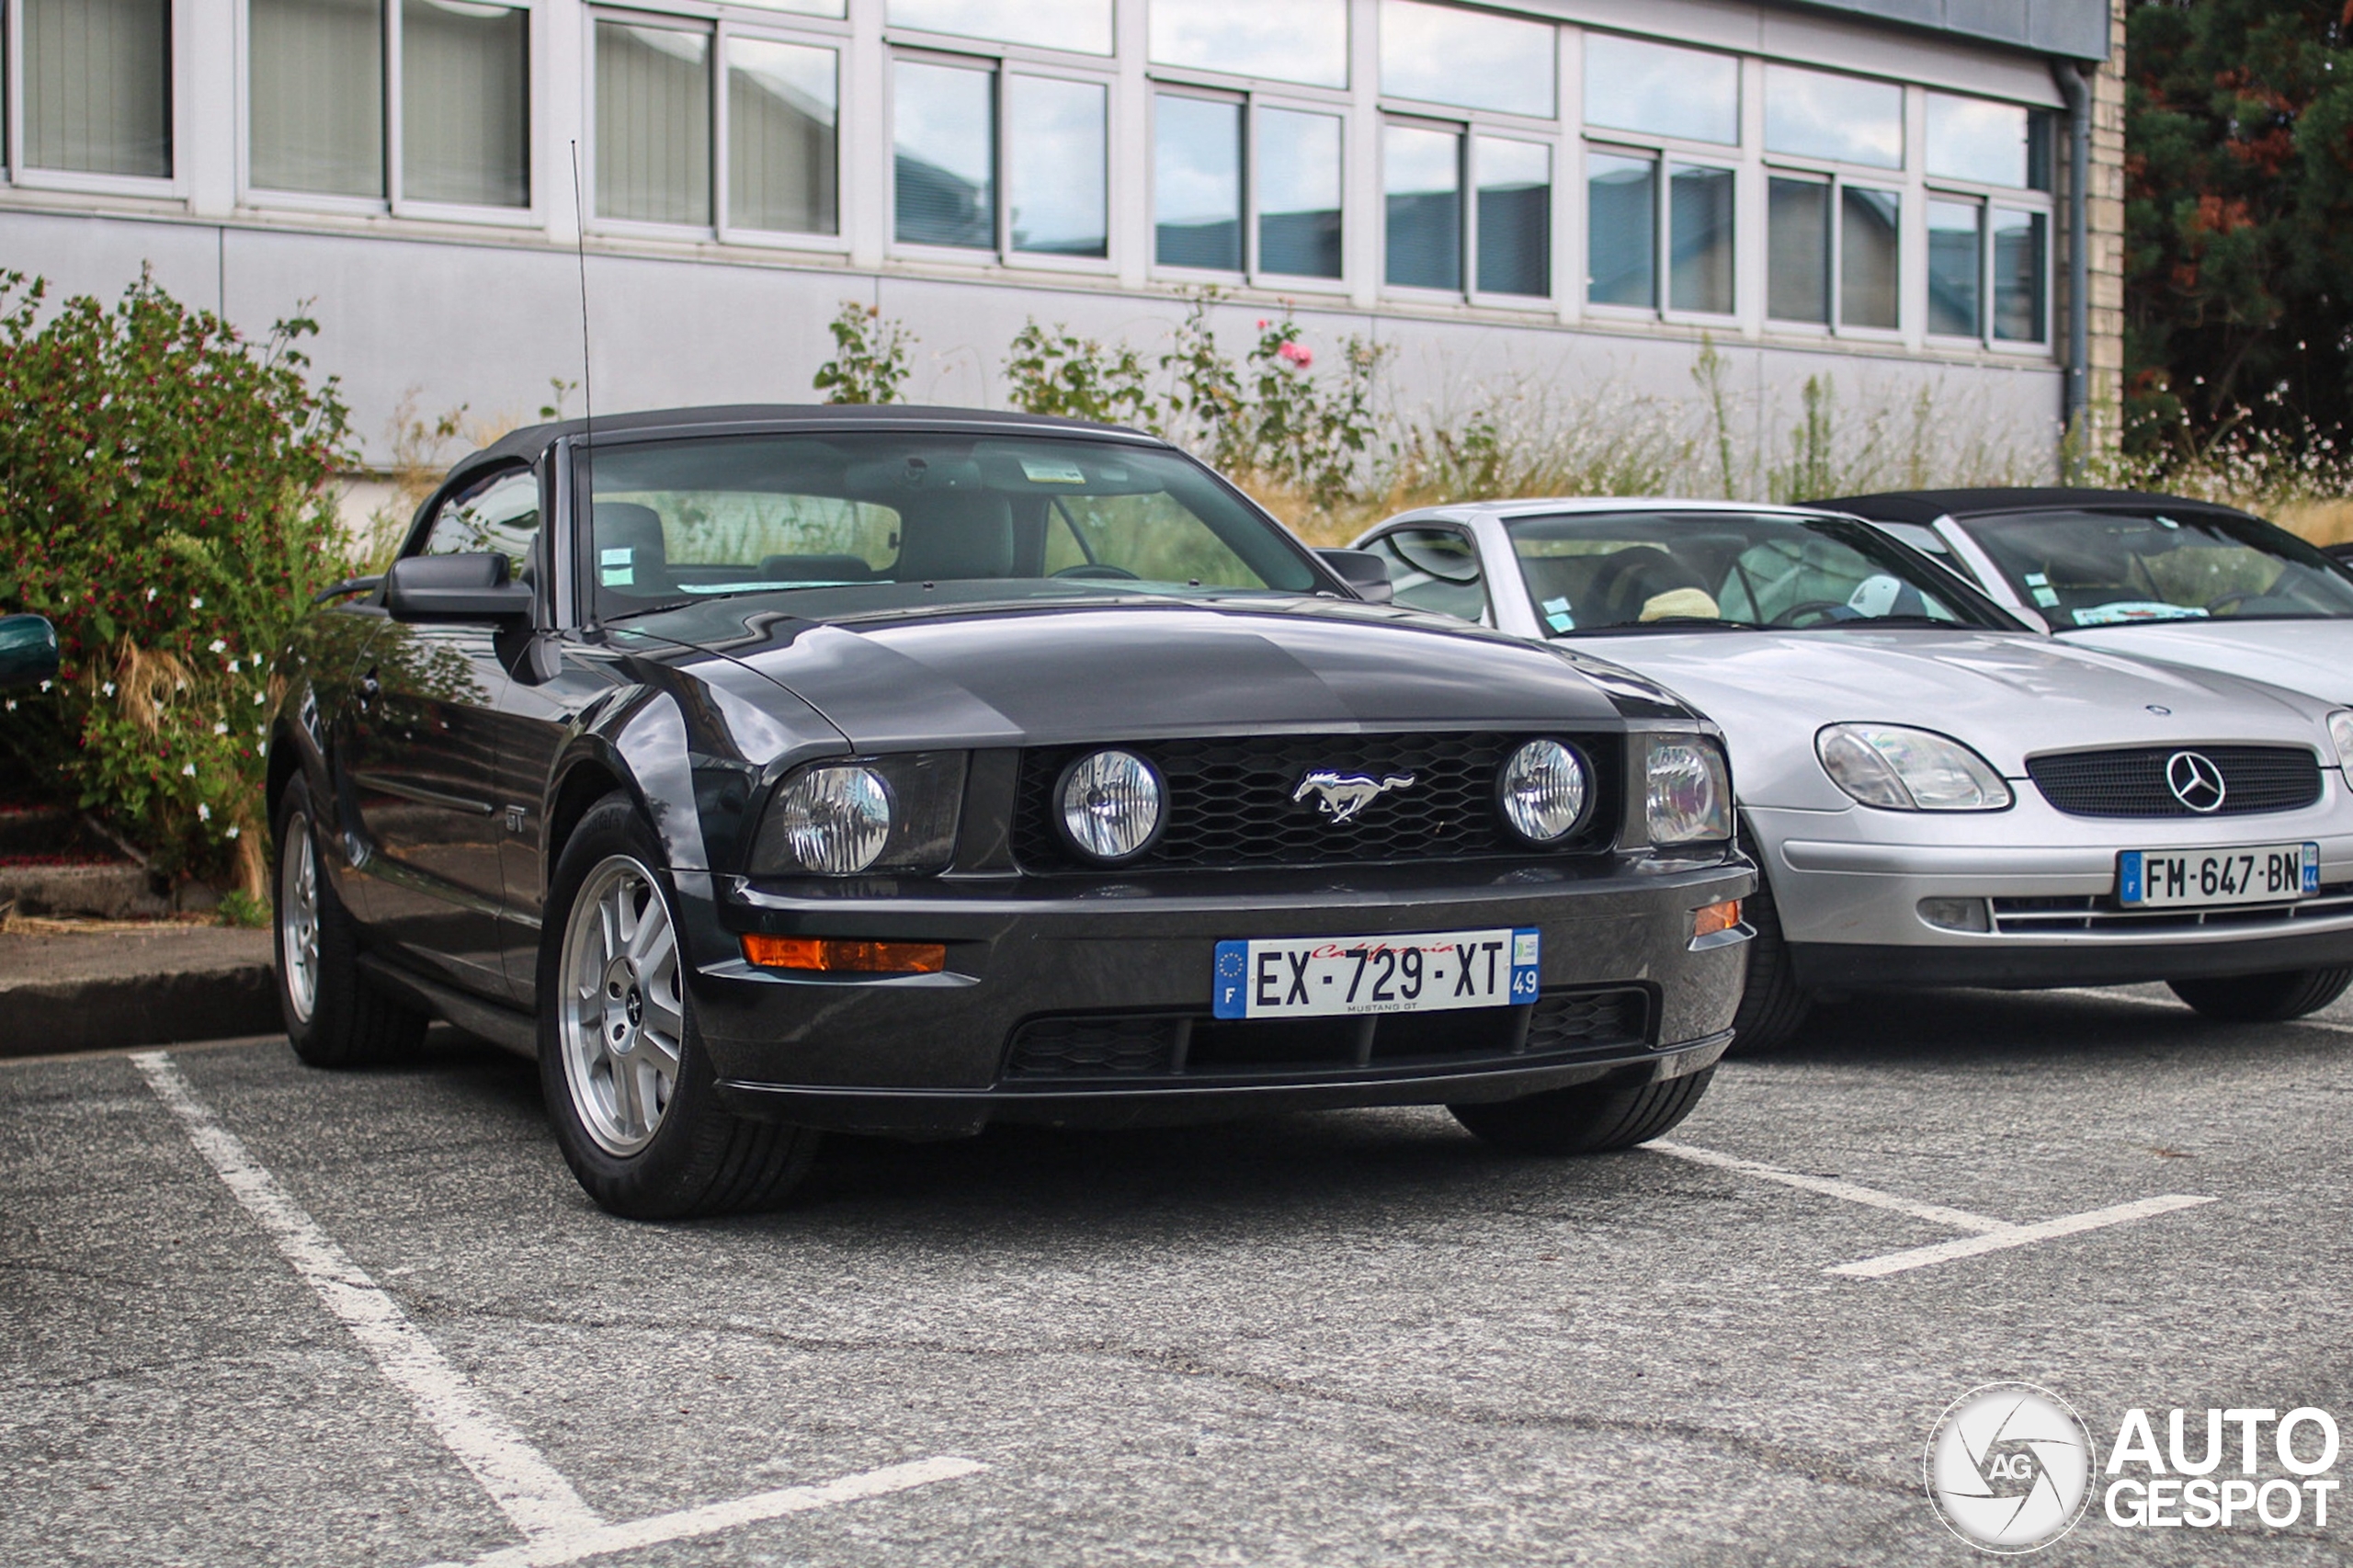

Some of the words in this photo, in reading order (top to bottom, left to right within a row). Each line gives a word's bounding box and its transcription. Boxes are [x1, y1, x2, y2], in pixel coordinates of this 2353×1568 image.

[2146, 852, 2299, 899] FM-647-BN
[1256, 941, 1504, 1006] EX-729-XT
[1512, 970, 1537, 994] 49
[1225, 987, 1235, 1004] F
[1347, 1003, 1401, 1013] MUSTANG
[1404, 1002, 1418, 1010] GT
